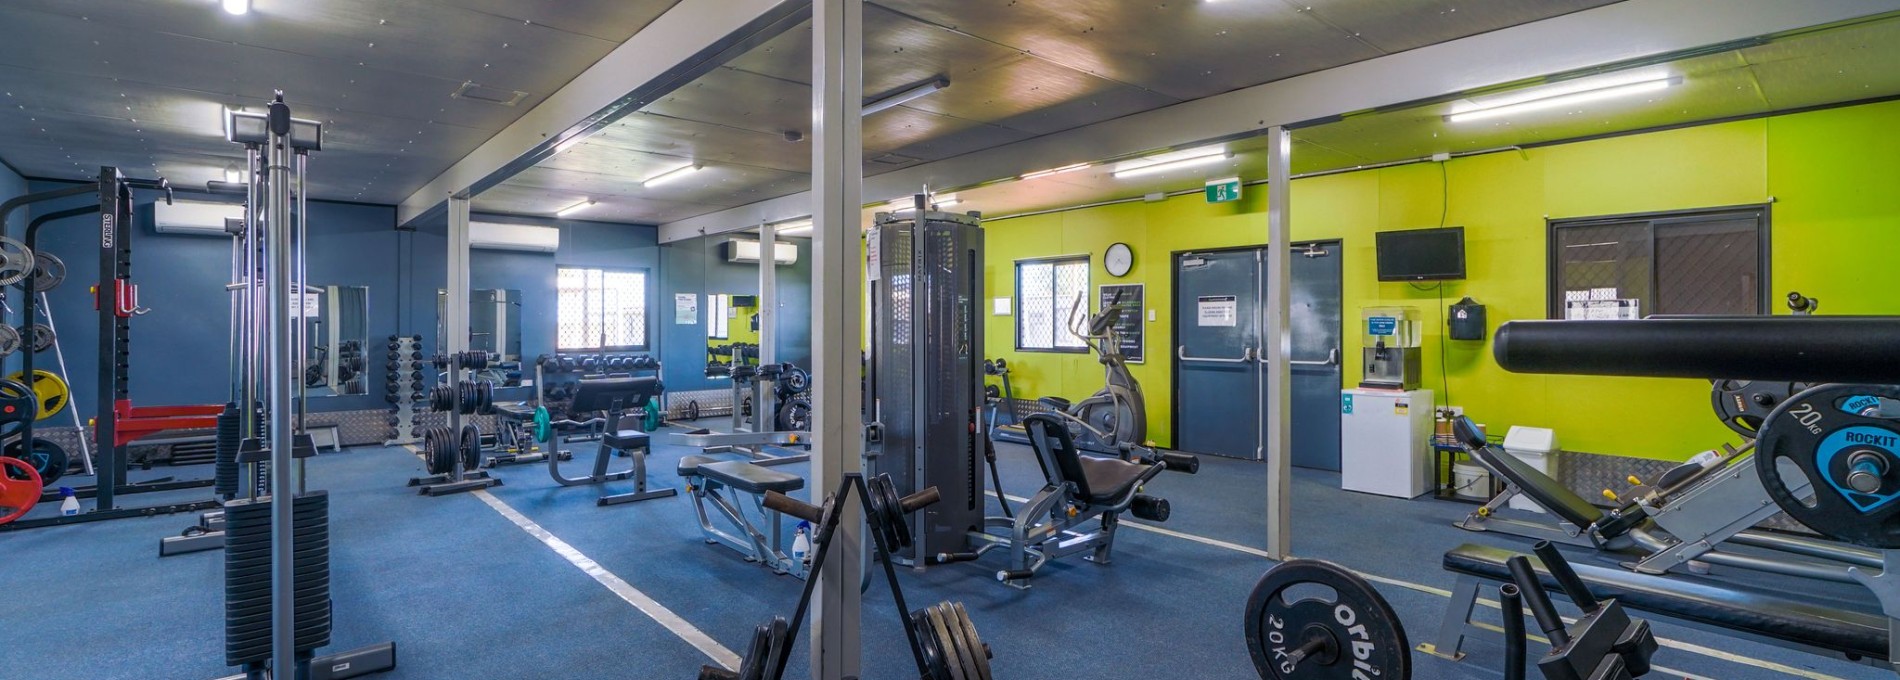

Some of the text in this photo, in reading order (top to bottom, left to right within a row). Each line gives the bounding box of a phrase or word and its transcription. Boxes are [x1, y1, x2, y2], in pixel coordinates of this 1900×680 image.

[103, 214, 112, 247] STERLING
[1788, 403, 1822, 435] 20KG
[1849, 396, 1880, 410] ROCKI
[1846, 431, 1897, 447] ROCKIT
[1269, 613, 1295, 674] 20KG
